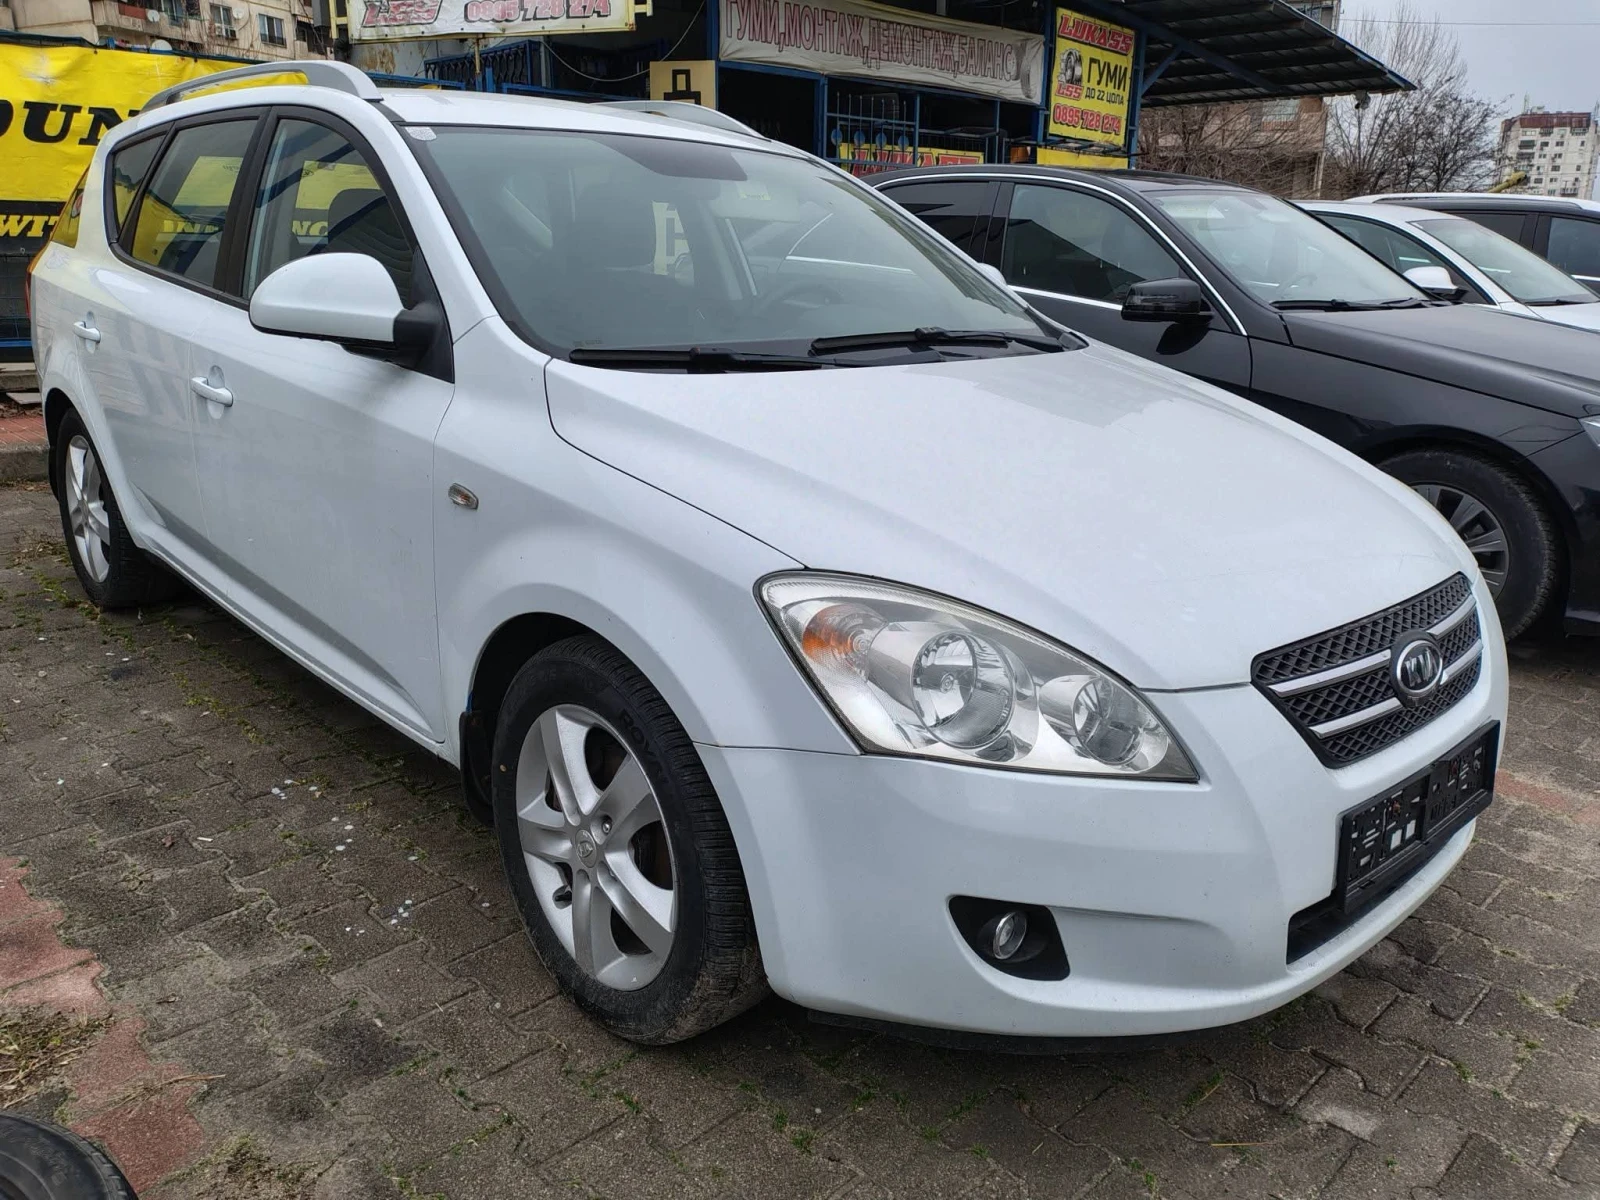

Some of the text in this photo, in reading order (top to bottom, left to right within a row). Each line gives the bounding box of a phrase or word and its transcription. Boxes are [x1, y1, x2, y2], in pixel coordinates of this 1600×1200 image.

[1058, 14, 1134, 56] LUKASS
[1087, 57, 1128, 92] ГУМИ
[1084, 87, 1096, 99] ДО
[1096, 88, 1105, 101] 22
[1053, 103, 1122, 135] 0895 728 274
